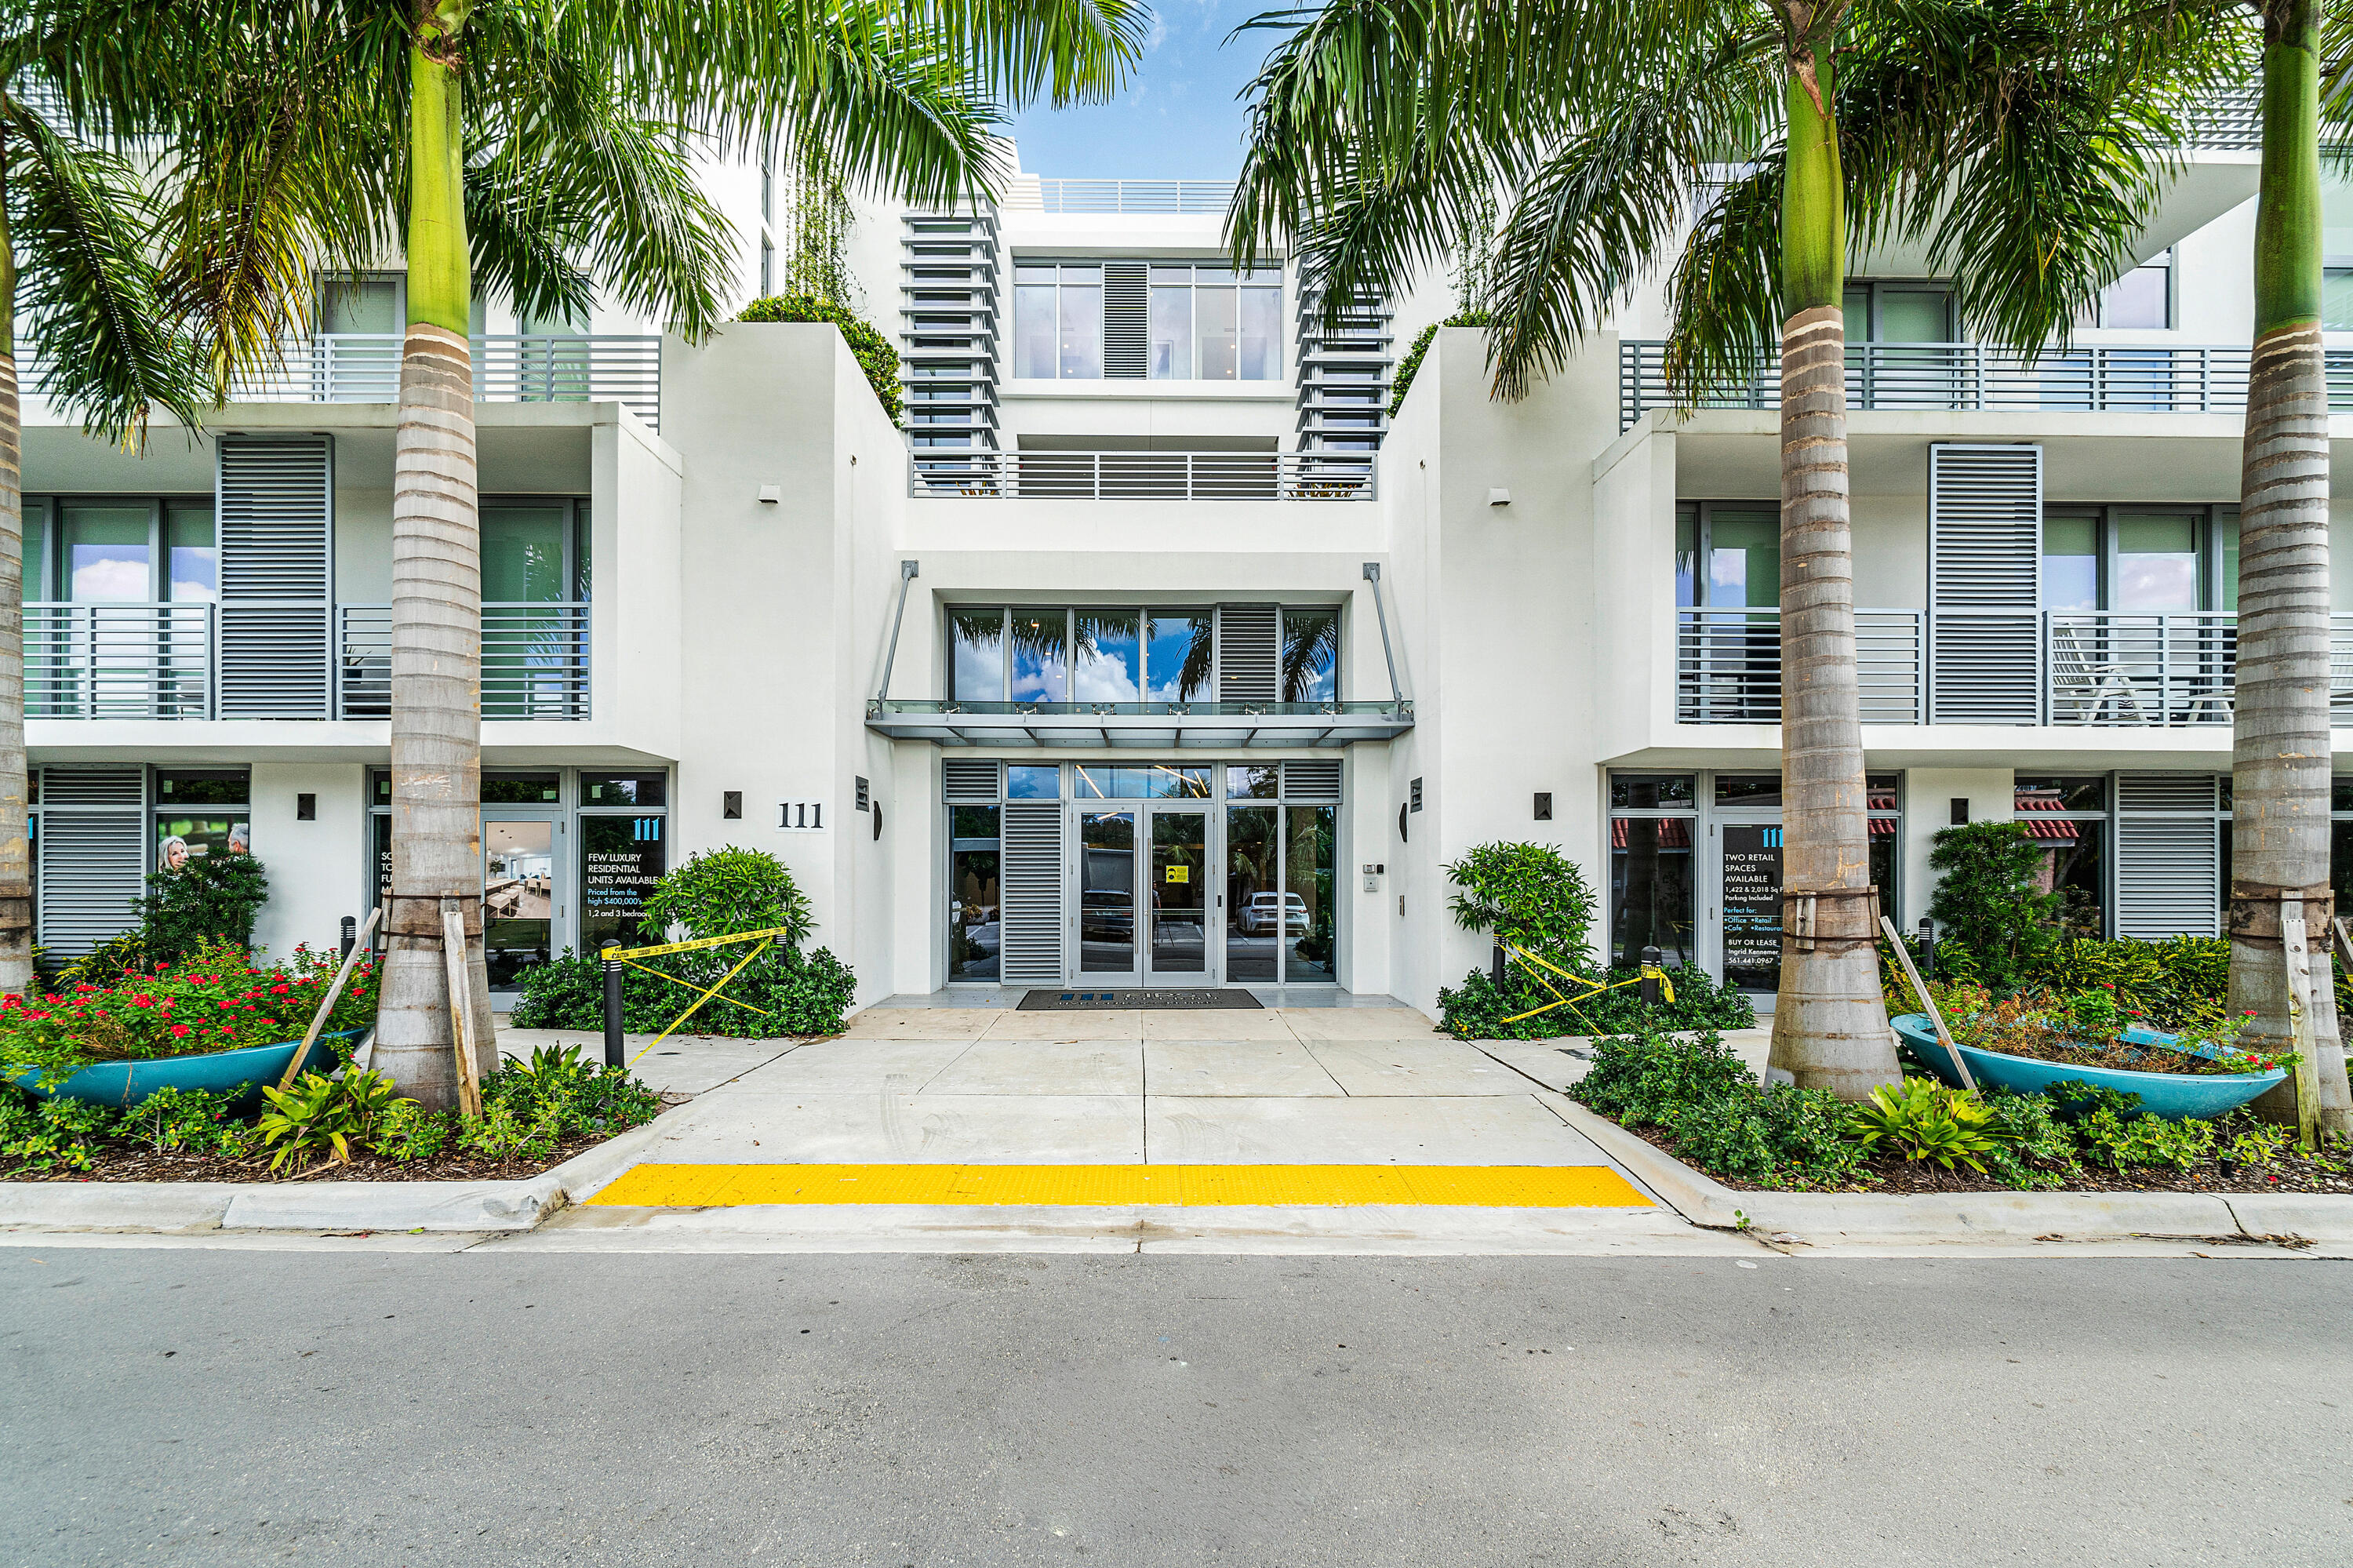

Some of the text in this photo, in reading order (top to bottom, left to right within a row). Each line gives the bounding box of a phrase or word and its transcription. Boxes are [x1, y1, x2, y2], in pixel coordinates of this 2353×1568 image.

[778, 802, 824, 828] 111
[633, 818, 659, 841] 111
[1762, 828, 1784, 848] 111
[588, 853, 642, 862] FEW LUXURY
[587, 864, 641, 873] RESIDENTIAL
[587, 875, 658, 885] UNITS AVAILABLE
[587, 897, 602, 906] high
[588, 909, 599, 918] 1,2
